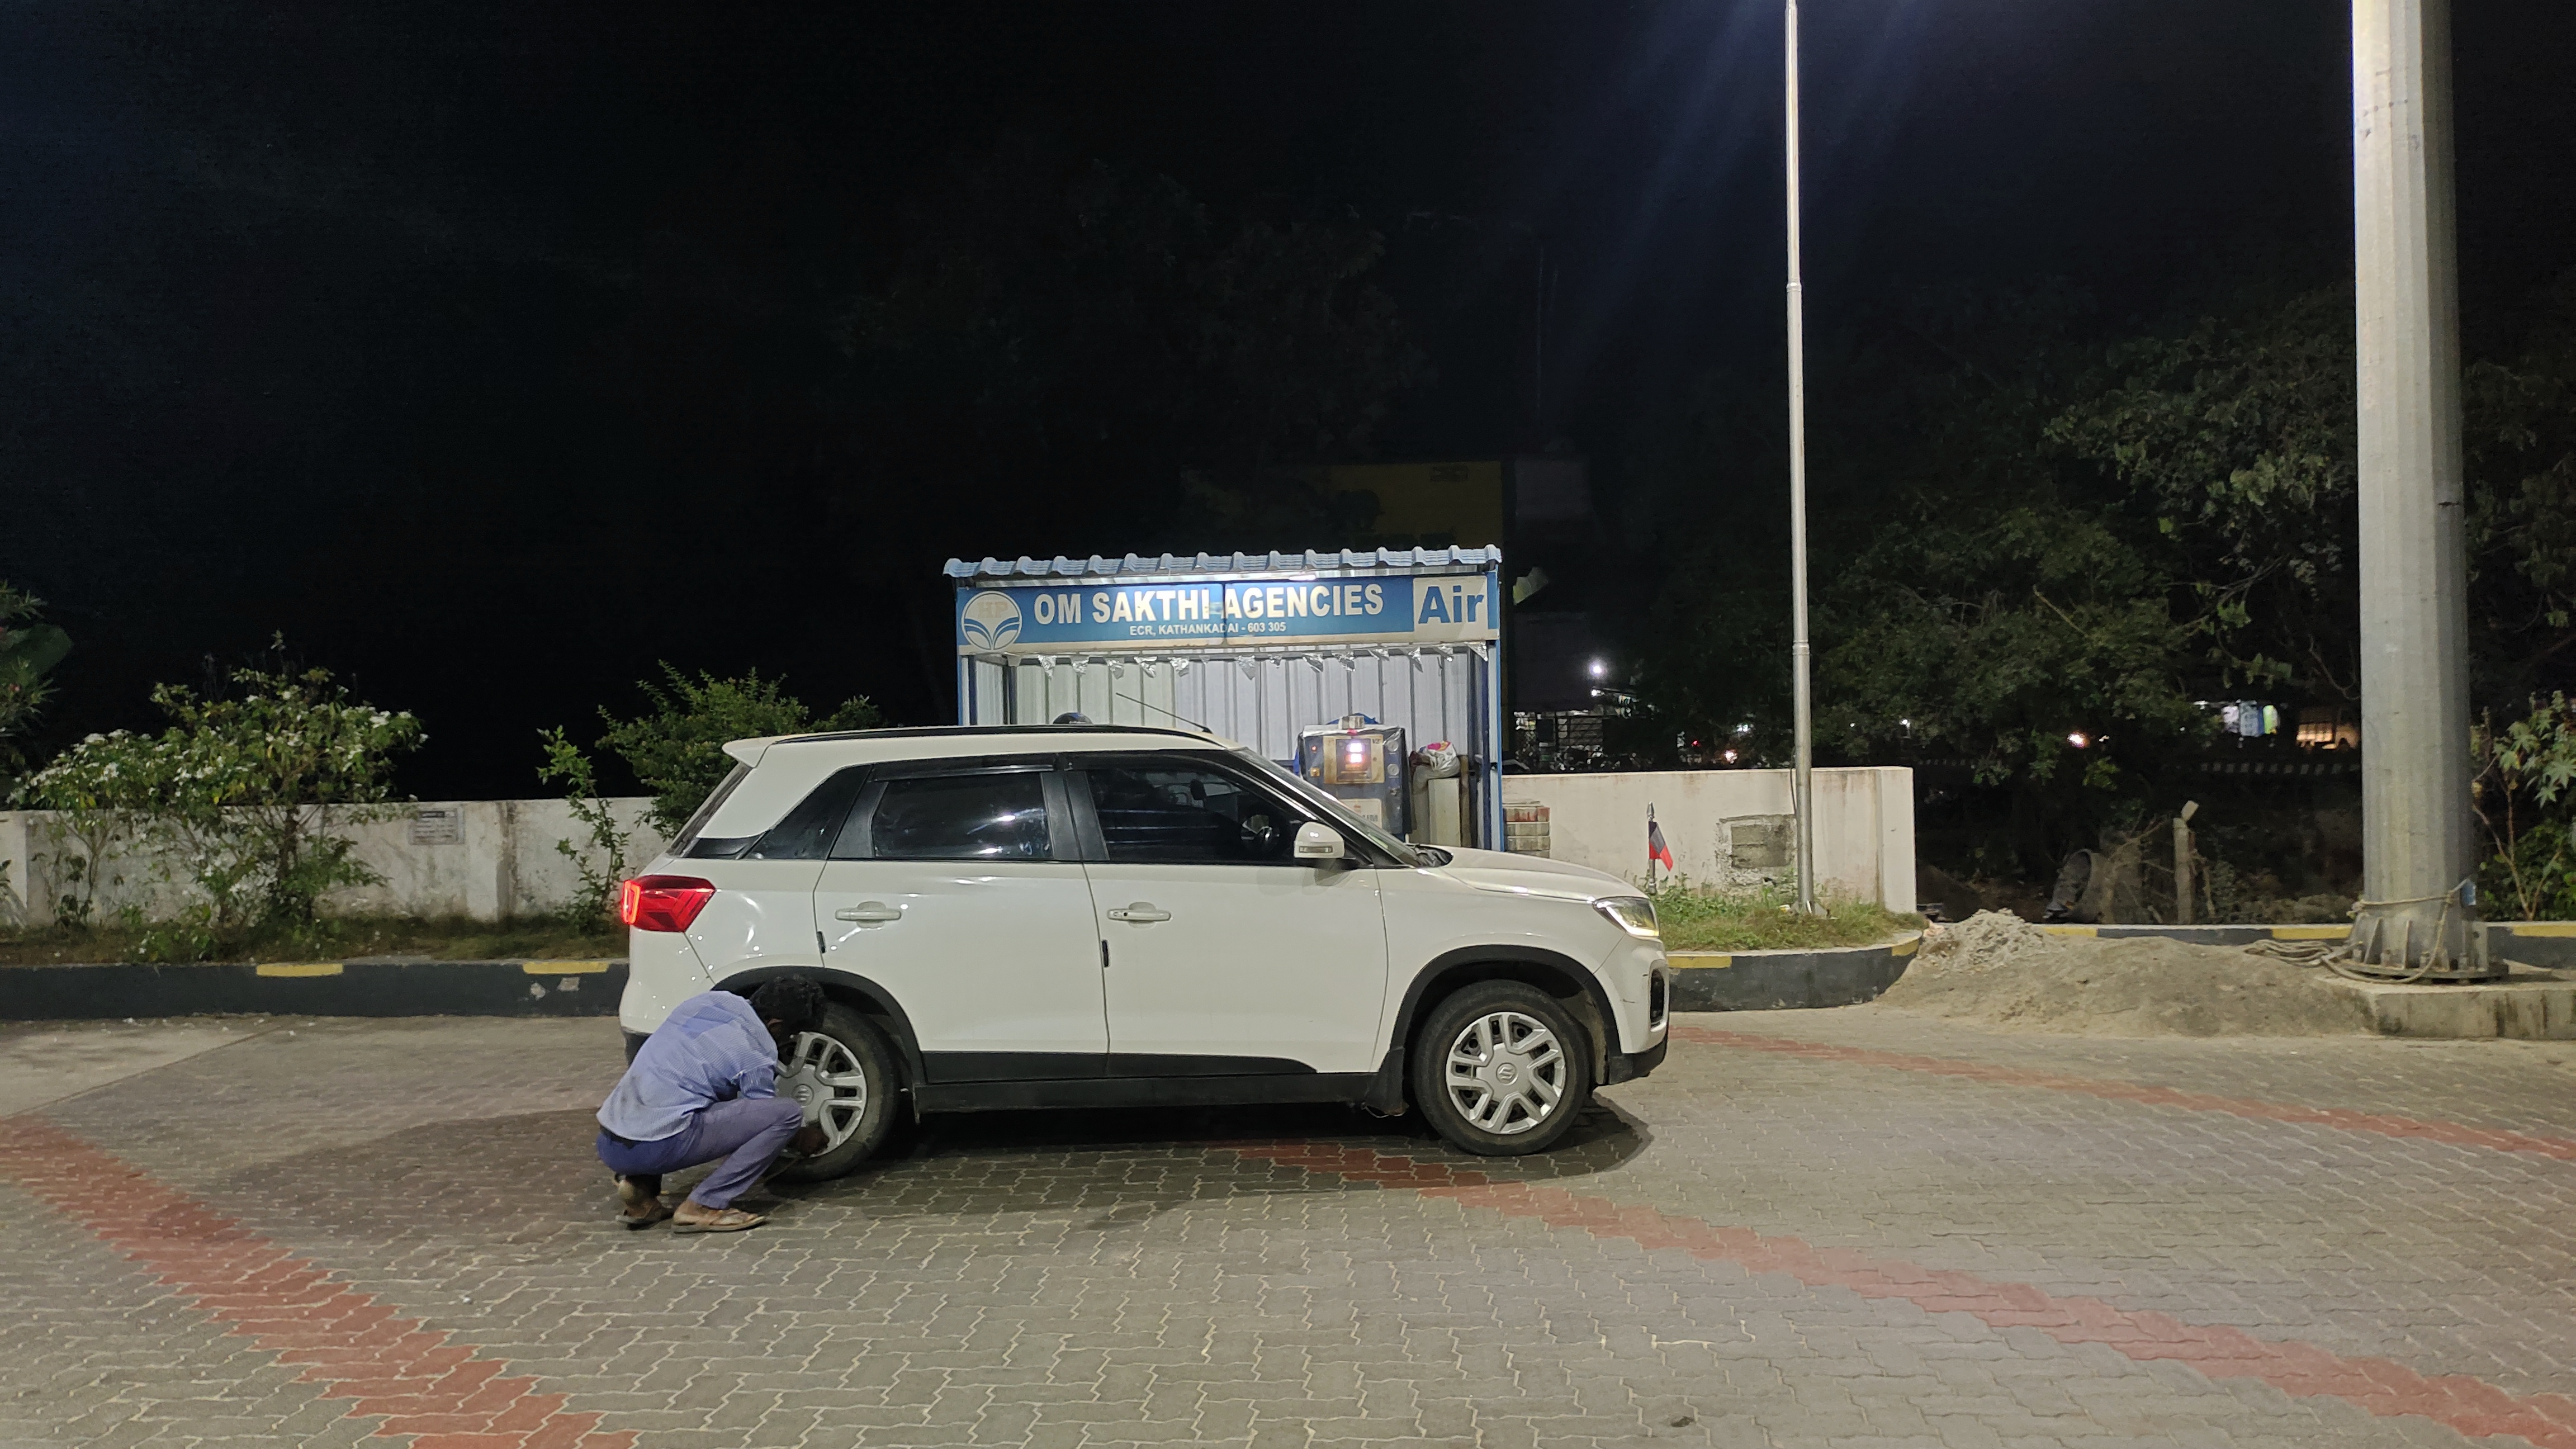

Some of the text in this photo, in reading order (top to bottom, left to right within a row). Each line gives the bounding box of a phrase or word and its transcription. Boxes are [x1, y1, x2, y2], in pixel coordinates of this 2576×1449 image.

[977, 602, 1008, 618] HP
[1034, 584, 1384, 624] OM SAKTHI AGENCIES
[1418, 585, 1484, 624] Air
[1129, 624, 1156, 636] ECR,
[1158, 623, 1239, 634] KATHANKADAI
[1247, 622, 1266, 633] 603
[1268, 621, 1286, 632] 305
